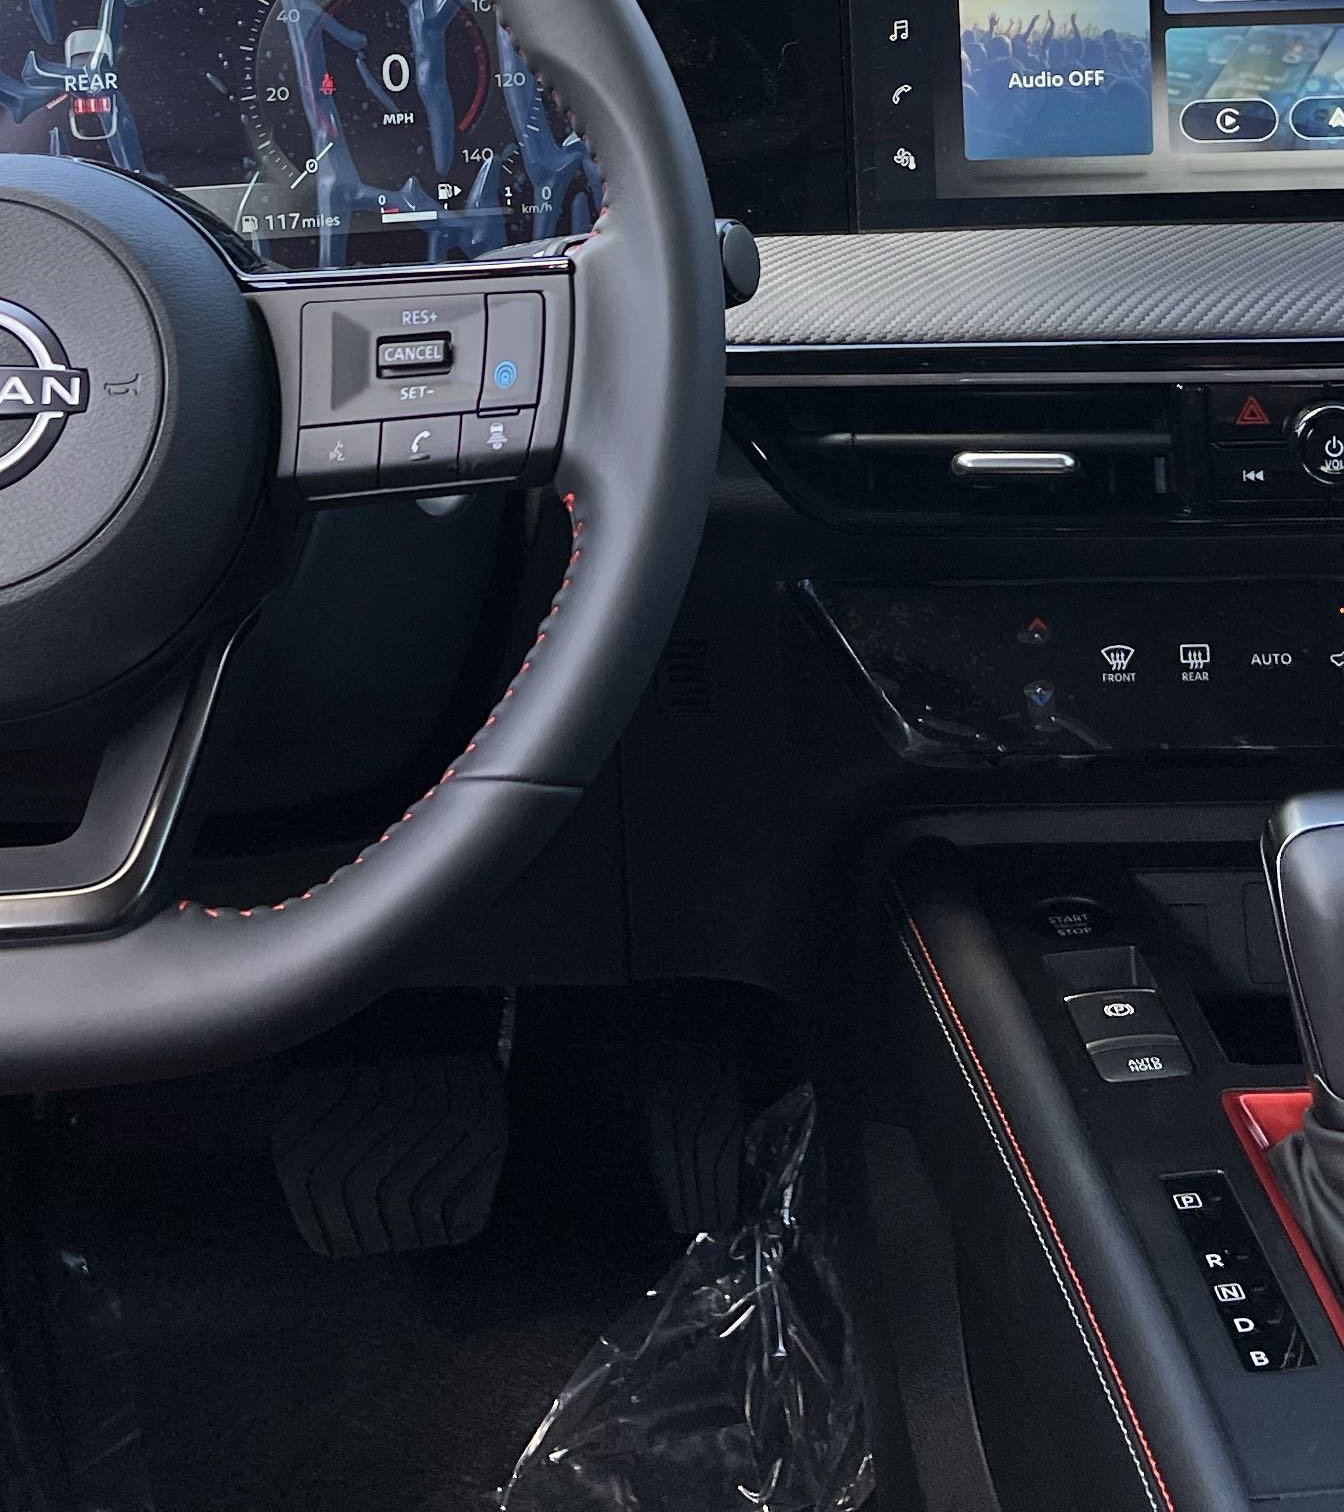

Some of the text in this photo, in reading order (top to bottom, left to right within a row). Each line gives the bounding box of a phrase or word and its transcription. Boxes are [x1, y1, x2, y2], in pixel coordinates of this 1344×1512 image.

[276, 8, 301, 24] 40
[382, 54, 411, 93] 0
[495, 71, 526, 88] 120
[1008, 70, 1105, 90] Audio OFF
[65, 73, 118, 91] REAR
[266, 86, 290, 103] 20
[382, 111, 415, 126] MPH
[462, 146, 495, 163] 140
[521, 200, 553, 215] km/h
[264, 212, 341, 231] 117 miles
[402, 311, 439, 326] RES+
[384, 345, 442, 362] CANCEL
[400, 386, 435, 401] SET-
[1324, 459, 1344, 470] VOL
[1251, 652, 1292, 667] AUTO
[1101, 672, 1136, 683] FRONT
[1181, 671, 1210, 682] REAR
[1048, 913, 1088, 924] START
[1057, 927, 1092, 937] STOP
[1127, 1056, 1160, 1066] AUTO
[1129, 1063, 1163, 1072] HOLD
[1180, 1195, 1194, 1207] P
[1205, 1254, 1224, 1268] R
[1221, 1287, 1239, 1299] N
[1233, 1318, 1255, 1333] D
[1249, 1351, 1269, 1366] B
